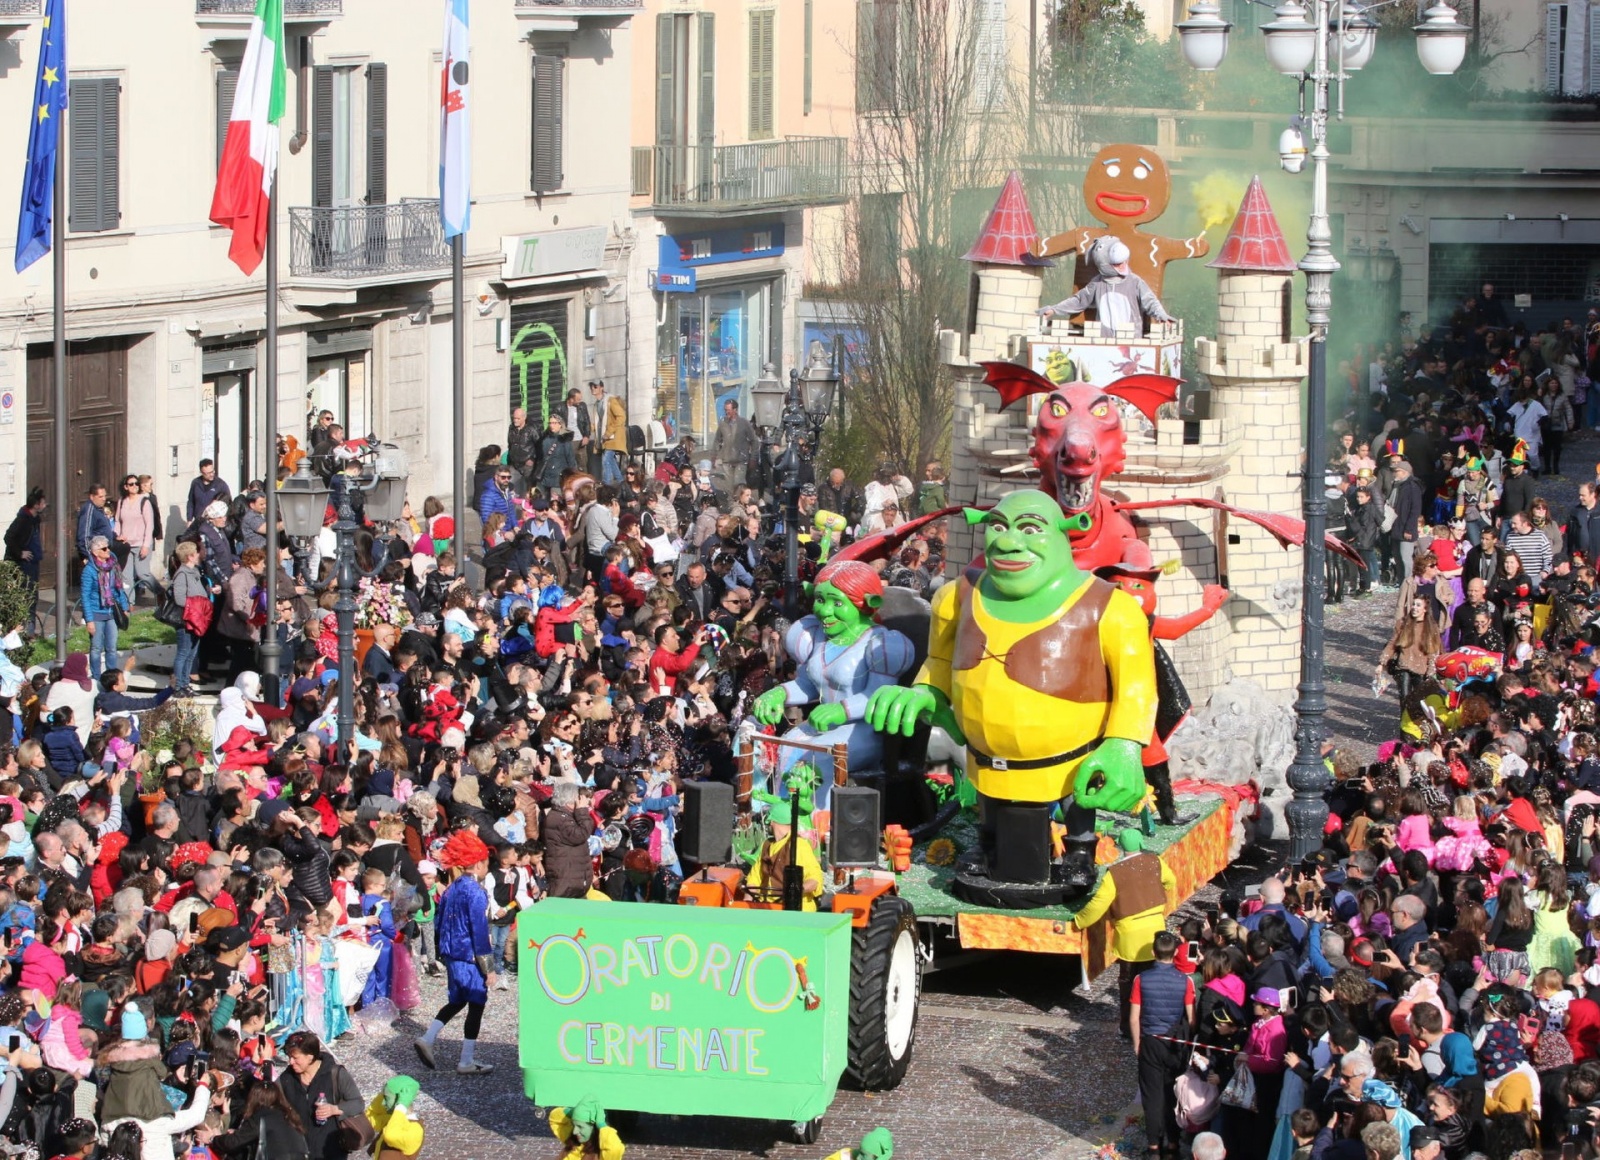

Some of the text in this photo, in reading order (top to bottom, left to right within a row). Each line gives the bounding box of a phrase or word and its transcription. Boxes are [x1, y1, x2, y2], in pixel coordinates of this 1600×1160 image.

[691, 238, 712, 259] TIM
[753, 230, 772, 251] TIM
[671, 274, 691, 285] TIM
[535, 934, 799, 1013] ORATORIO
[650, 992, 671, 1011] DI
[558, 1020, 769, 1076] CERMENATE
